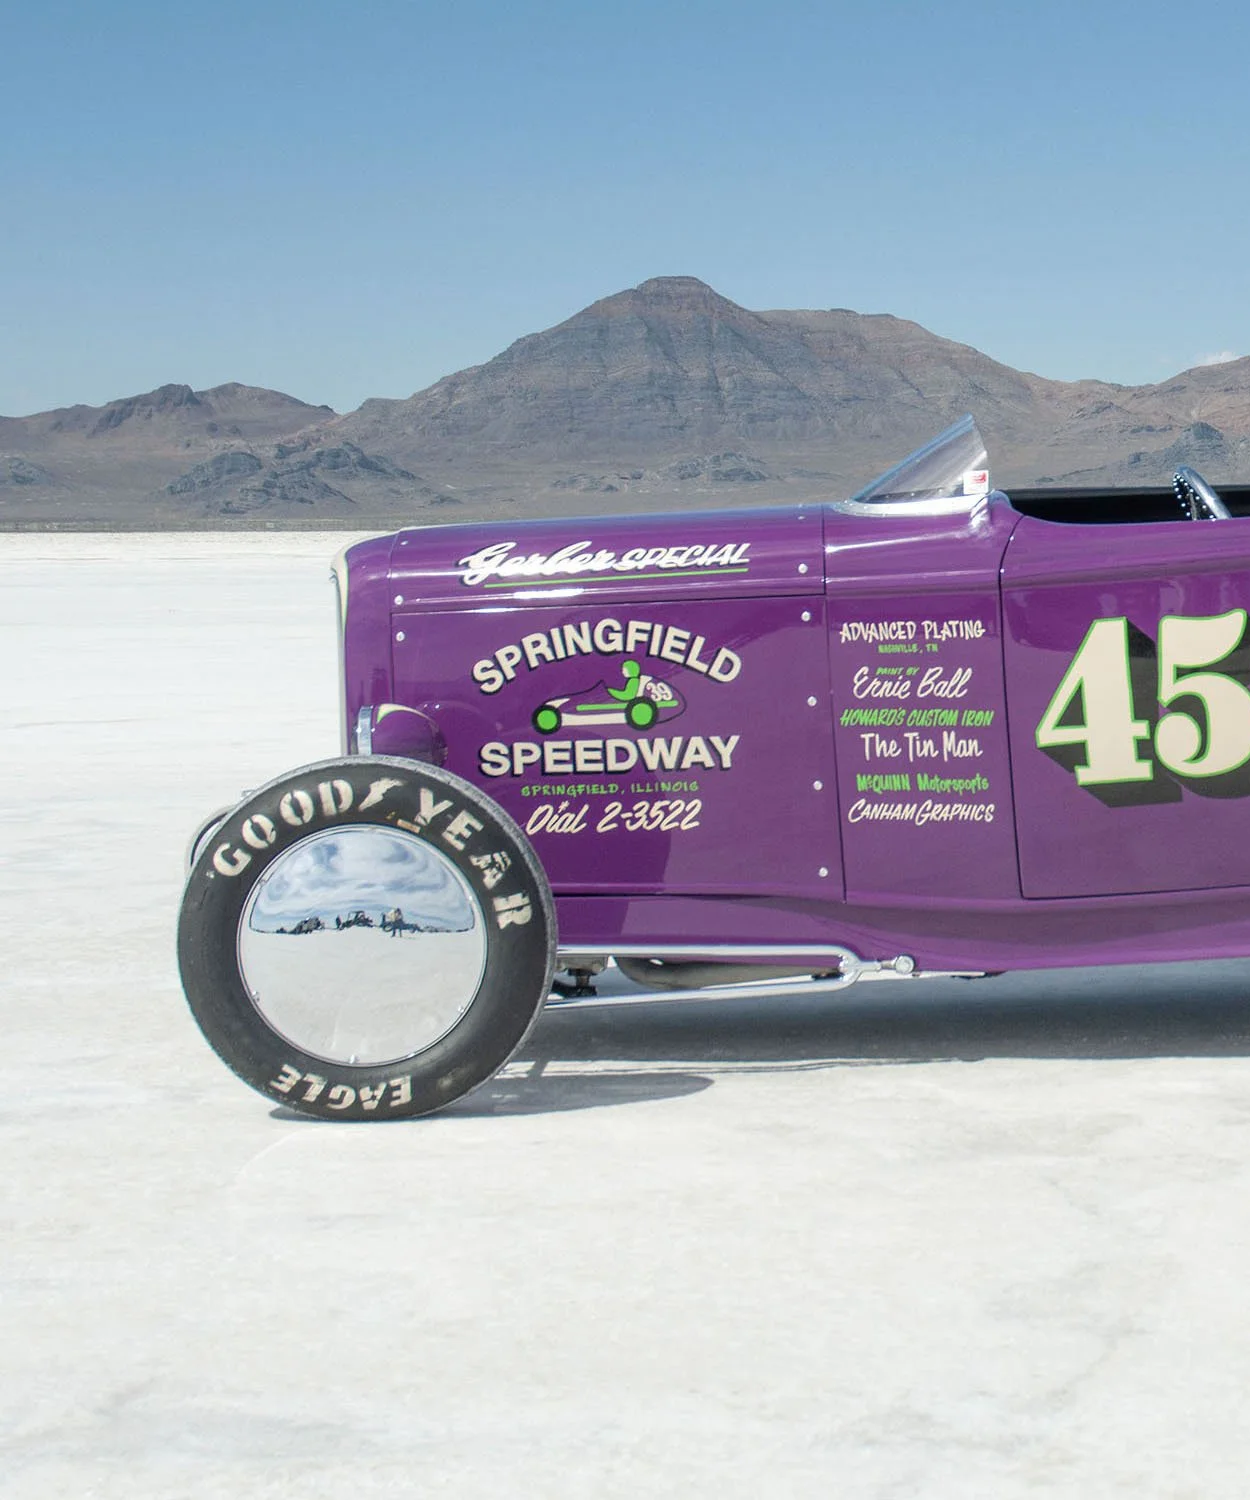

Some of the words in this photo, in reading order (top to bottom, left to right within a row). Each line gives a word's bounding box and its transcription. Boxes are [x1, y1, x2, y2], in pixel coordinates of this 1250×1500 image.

[459, 541, 617, 585] Gerber
[613, 543, 750, 571] SPECIAL
[840, 621, 917, 643] ADVANCED
[921, 620, 986, 641] PLATING
[472, 618, 742, 693] SPRINGFIELD
[646, 681, 673, 702] 39
[853, 666, 911, 699] Ernie
[916, 666, 972, 698] Ball
[840, 708, 905, 727] HOWARD'S
[906, 709, 958, 727] CUSTOM
[961, 710, 995, 727] IRON
[480, 735, 740, 776] SPEEDWAY
[860, 732, 902, 761] The
[903, 732, 940, 762] Tin
[943, 730, 983, 762] Man
[631, 780, 699, 793] ILLINOIS
[917, 773, 990, 796] Motorsports
[526, 801, 588, 835] Dial
[596, 799, 702, 833] 2-3522
[848, 798, 917, 824] CANHAM
[914, 799, 995, 826] GRAPHICS
[269, 1064, 413, 1109] EAGLE
